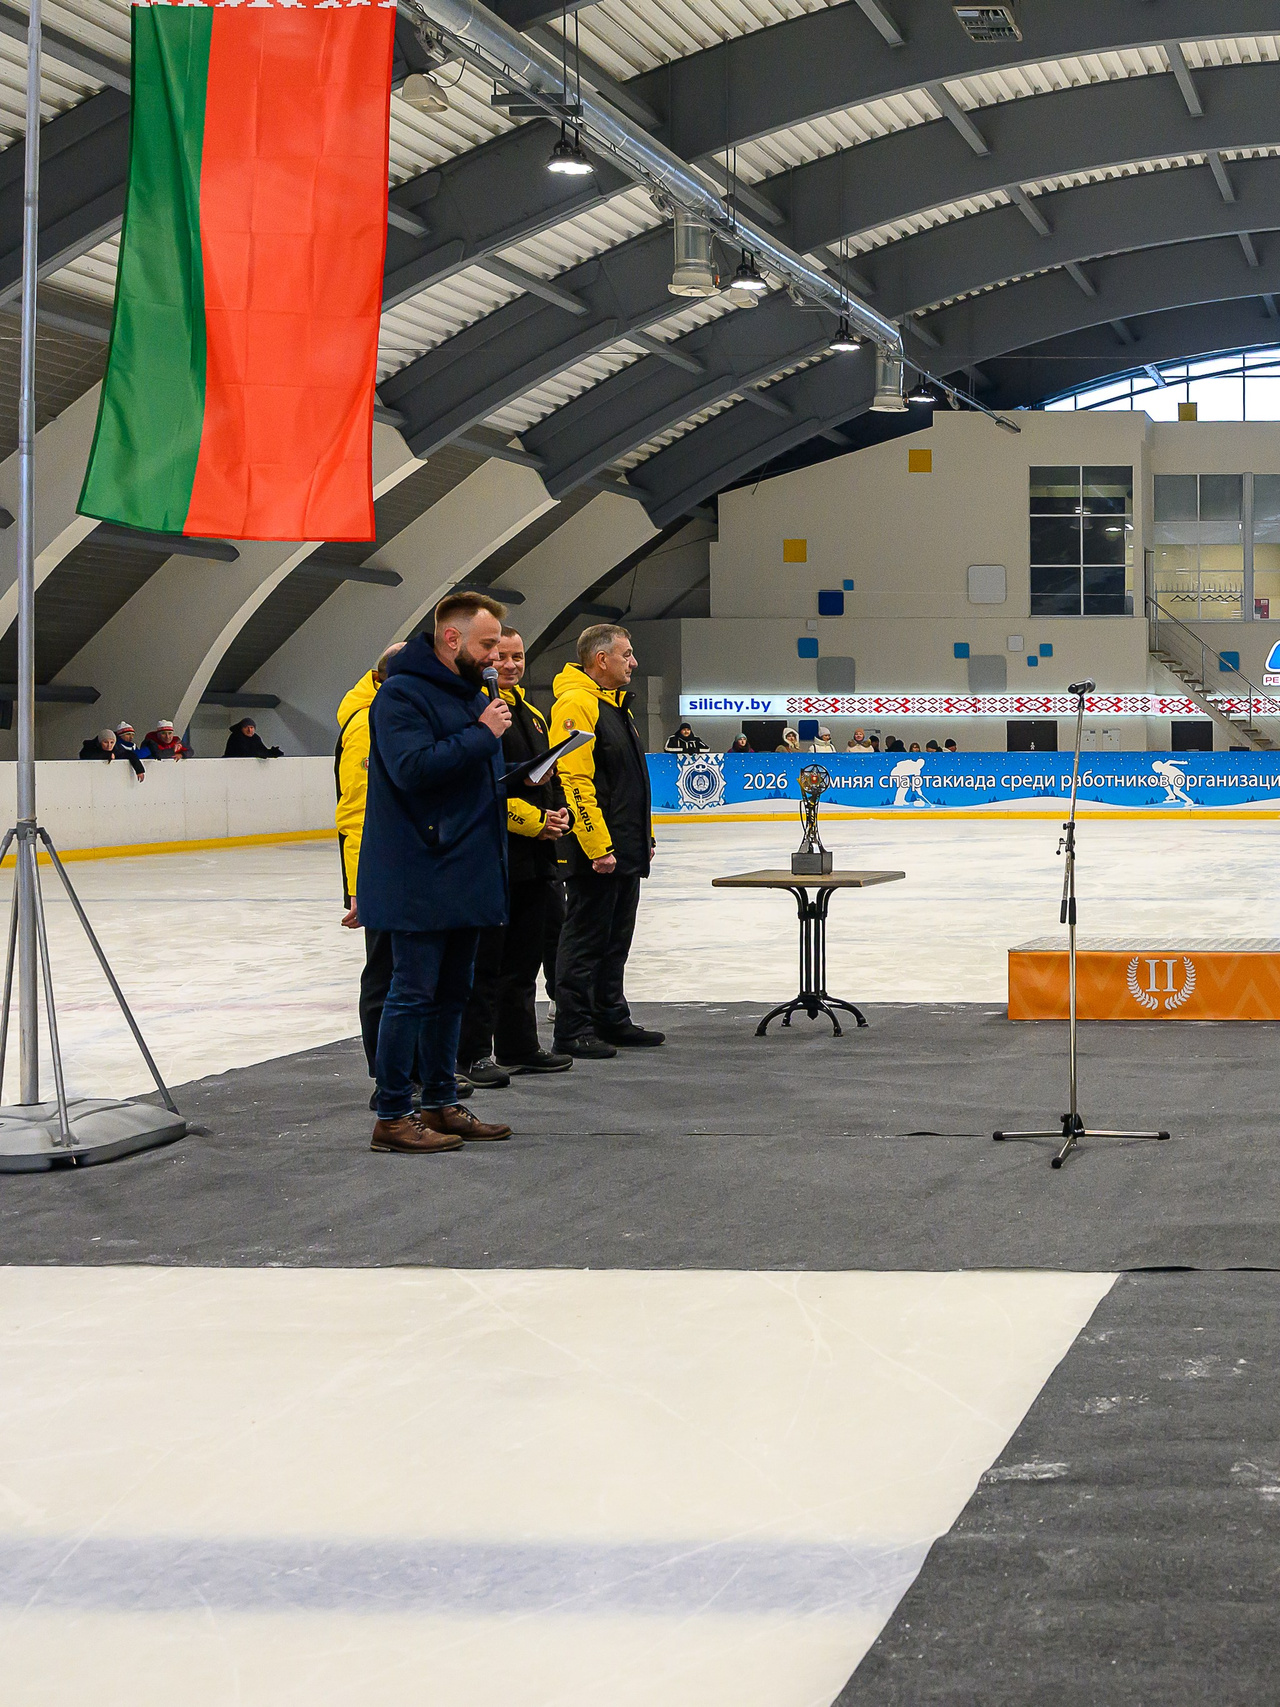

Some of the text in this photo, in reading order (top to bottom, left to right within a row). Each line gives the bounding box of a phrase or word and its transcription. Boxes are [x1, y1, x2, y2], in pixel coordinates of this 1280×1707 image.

[689, 698, 772, 713] silichy.by
[743, 773, 788, 790] 2026
[829, 775, 874, 789] мняя
[879, 774, 996, 791] спартакиада
[1001, 774, 1055, 791] среди
[1060, 770, 1170, 791] работников
[573, 788, 594, 833] BELARUS
[1145, 959, 1178, 993] II
